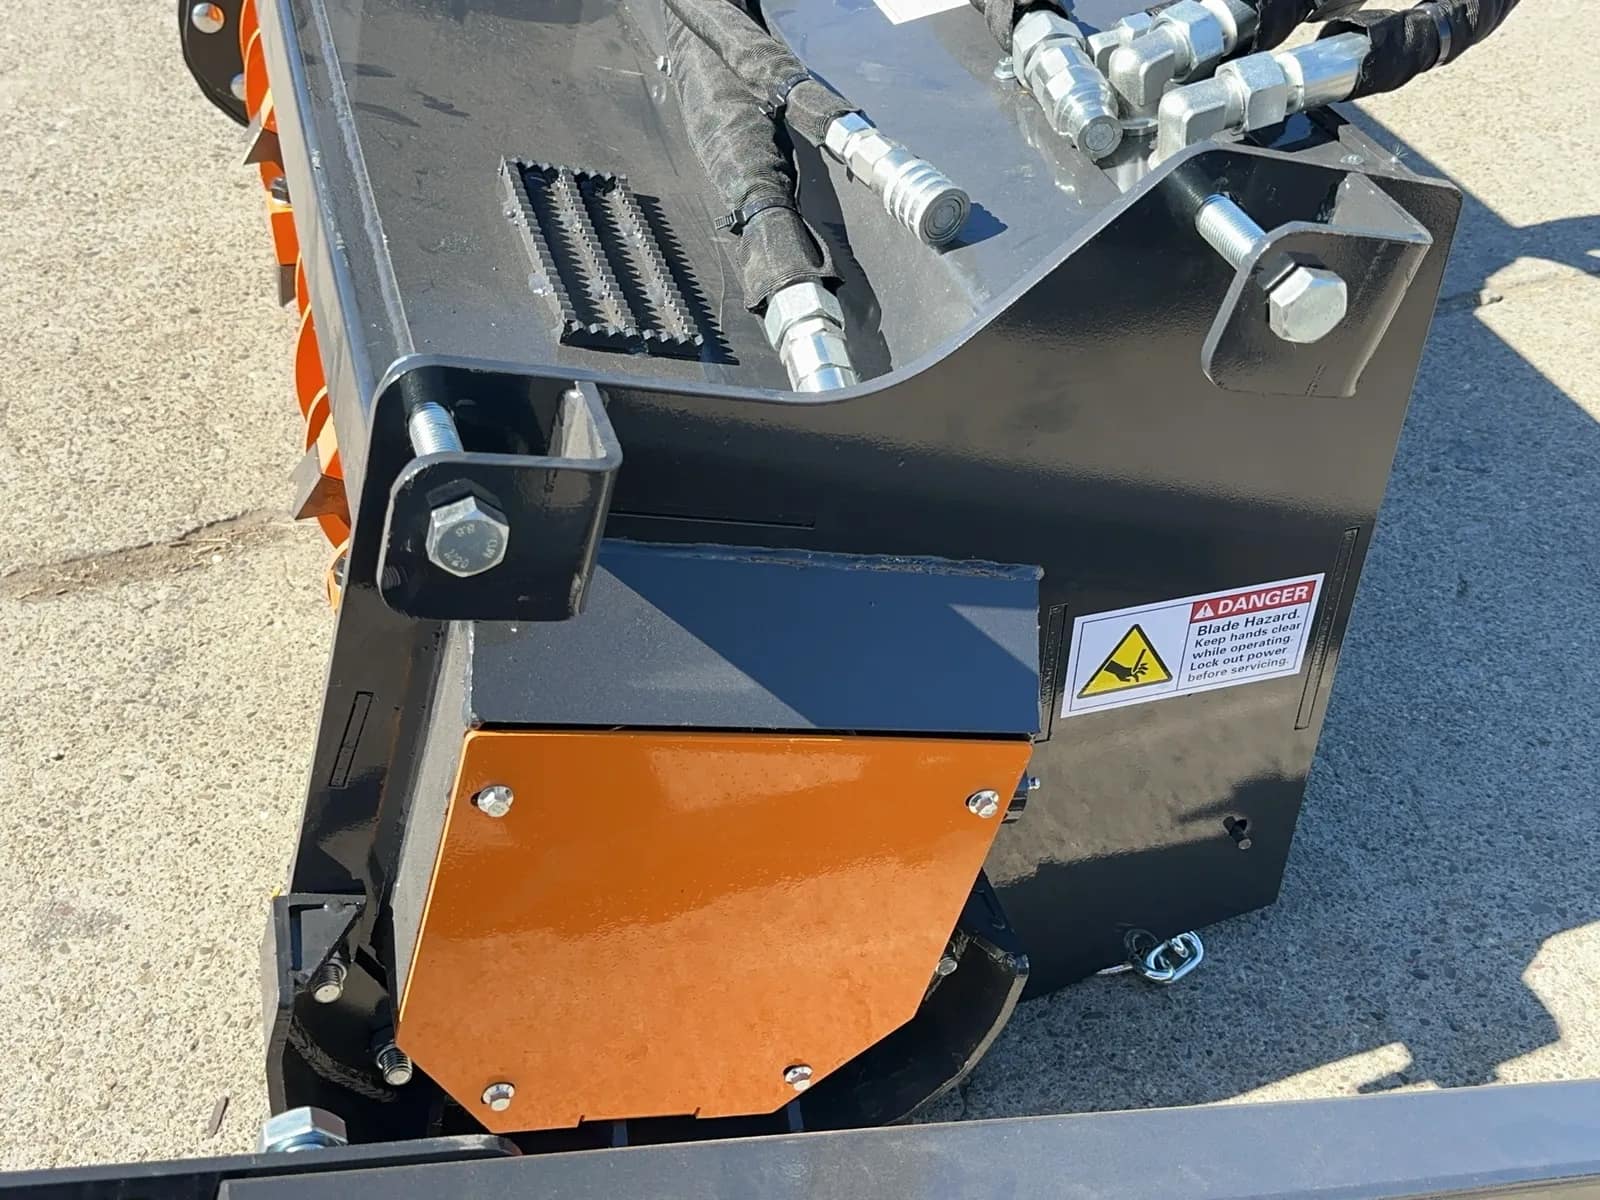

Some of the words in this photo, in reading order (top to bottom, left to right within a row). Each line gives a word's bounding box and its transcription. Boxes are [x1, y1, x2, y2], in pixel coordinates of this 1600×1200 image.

[1218, 586, 1309, 615] DANGER
[1195, 637, 1225, 648] Keep
[1230, 628, 1267, 641] hands
[1272, 622, 1301, 634] clear
[1198, 621, 1239, 636] Blade
[1245, 609, 1299, 627] Hazard.
[1191, 659, 1218, 670] Lock
[1223, 654, 1244, 664] out
[1247, 647, 1287, 662] power
[1193, 647, 1226, 659] while
[1231, 634, 1293, 653] operating.
[1188, 668, 1228, 681] before
[1231, 657, 1289, 673] servicing.
